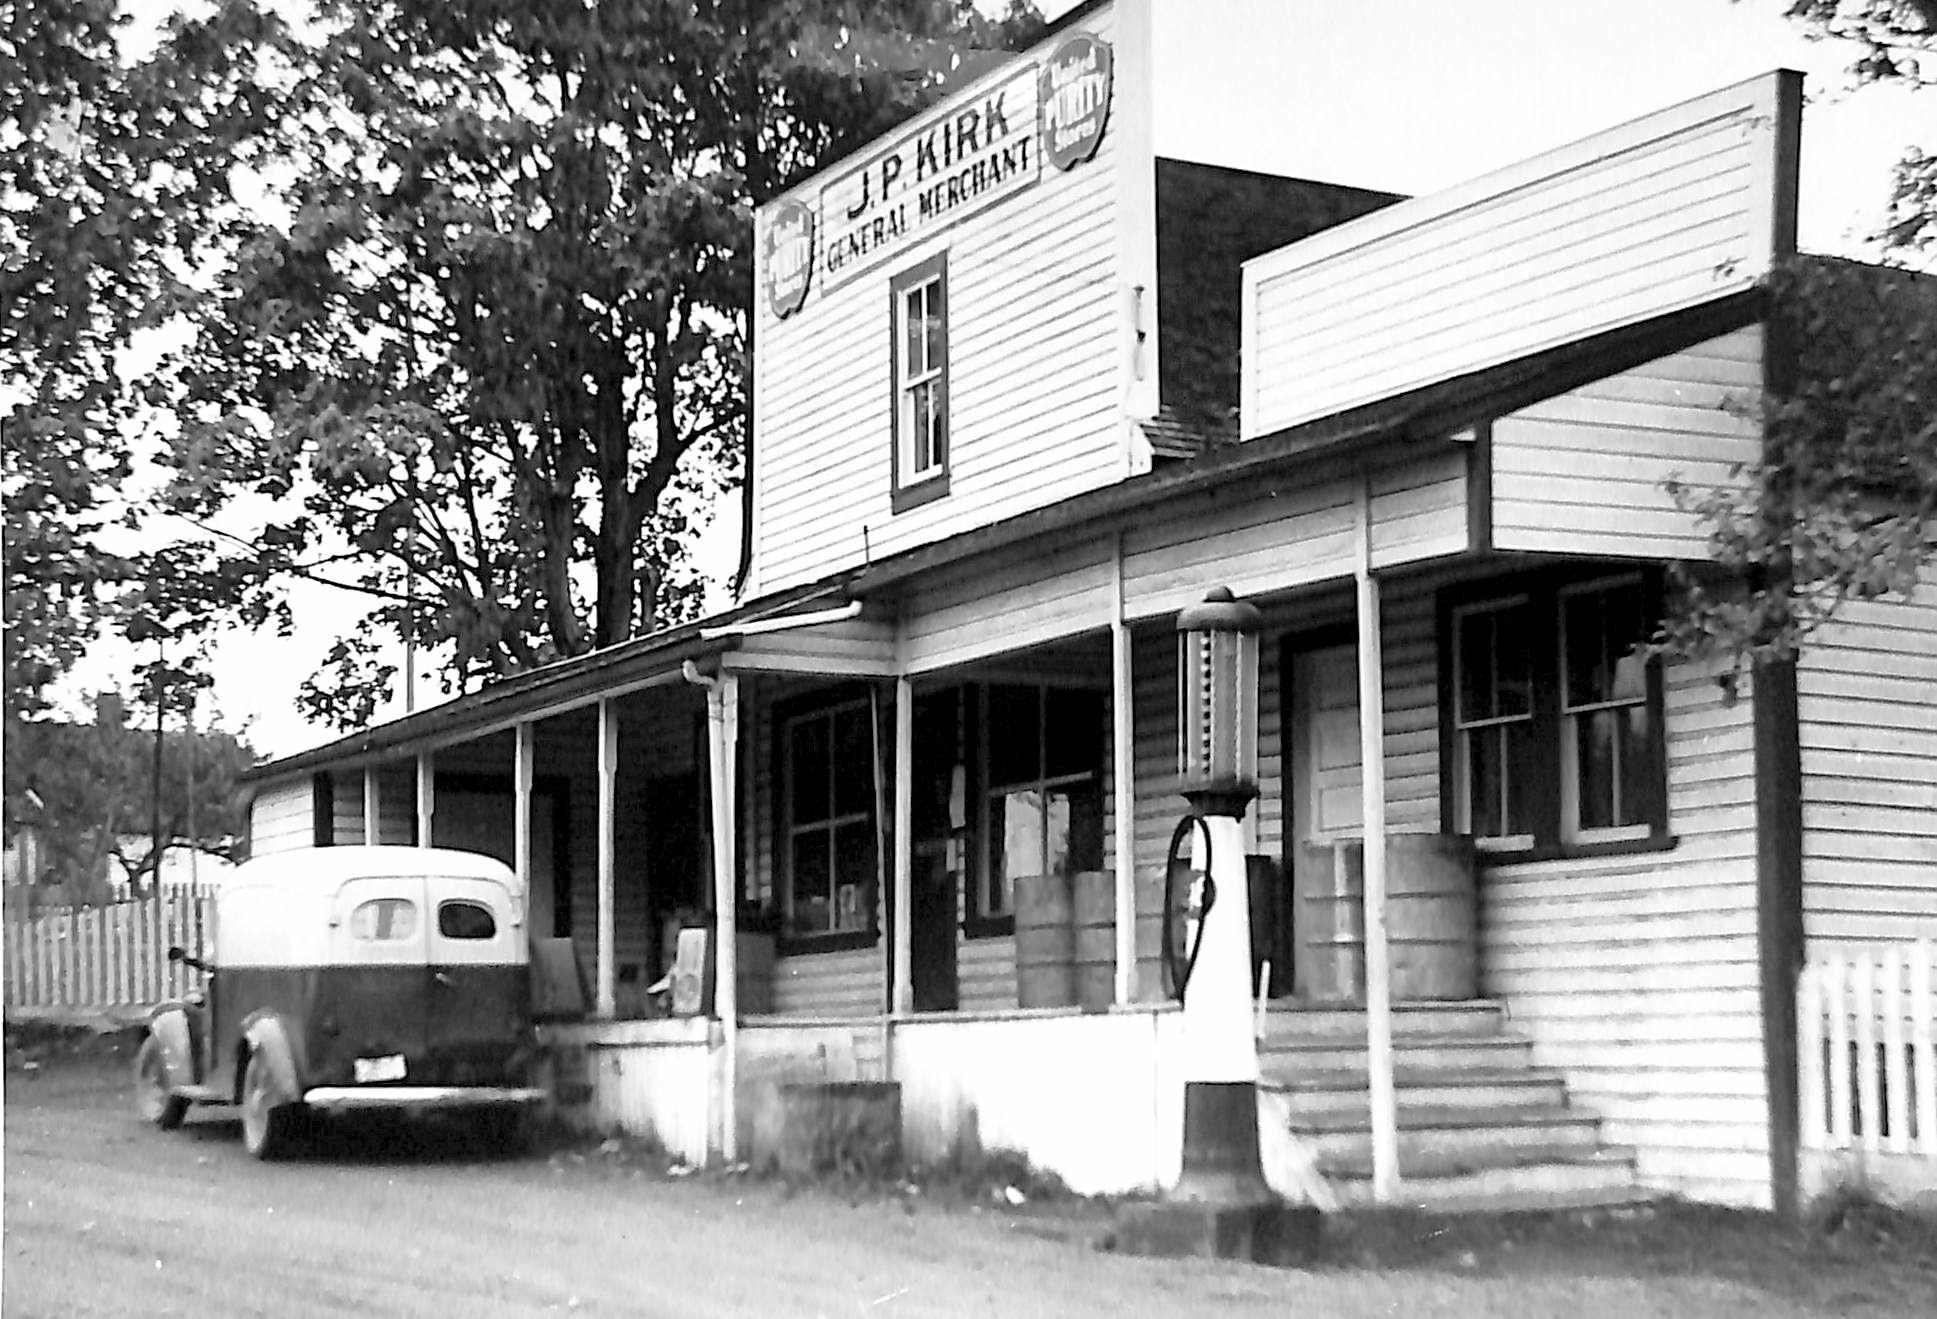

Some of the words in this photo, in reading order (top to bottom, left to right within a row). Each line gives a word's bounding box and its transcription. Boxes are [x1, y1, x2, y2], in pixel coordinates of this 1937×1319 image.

[917, 92, 1009, 182] KIRK
[827, 204, 909, 272] GENERAL
[919, 136, 1030, 223] MERCHANT
